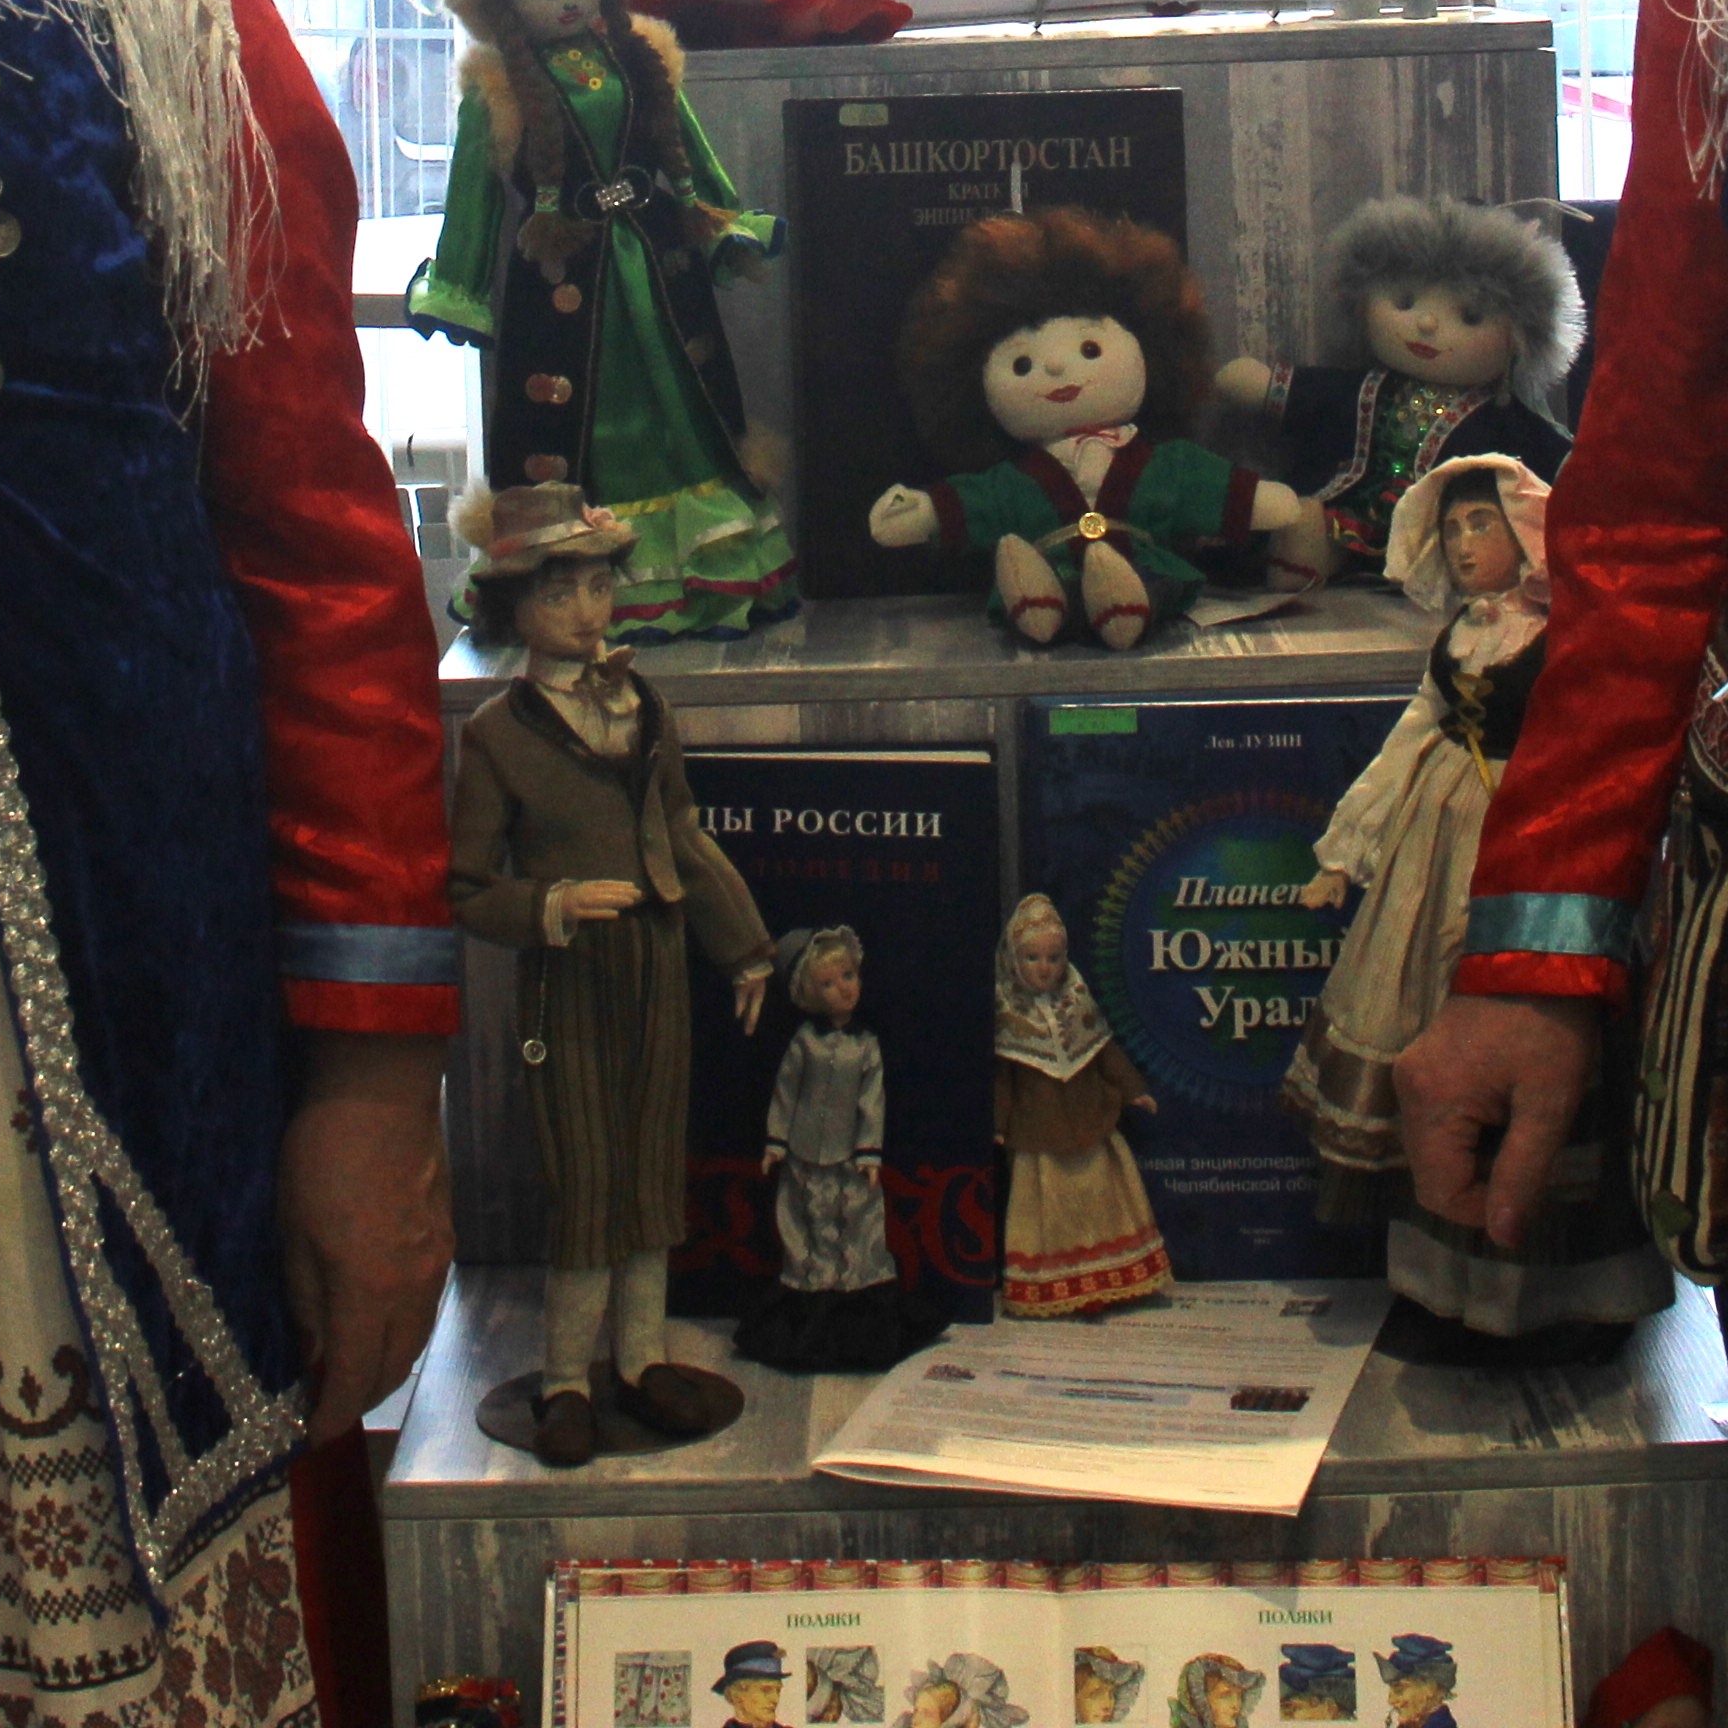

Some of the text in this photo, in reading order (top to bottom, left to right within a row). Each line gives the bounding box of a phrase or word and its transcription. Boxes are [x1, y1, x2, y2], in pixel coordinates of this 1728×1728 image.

[843, 136, 1132, 176] БАШКОРТОСТАН
[1204, 733, 1303, 749] Лев ЛУЗИН
[772, 808, 943, 838] РОССИИ
[1147, 926, 1344, 972] Южны
[1165, 1176, 1281, 1194] Челябинской
[787, 1611, 861, 1629] ПОЛЯКИ
[1258, 1608, 1333, 1626] ПОЛЯКИ
